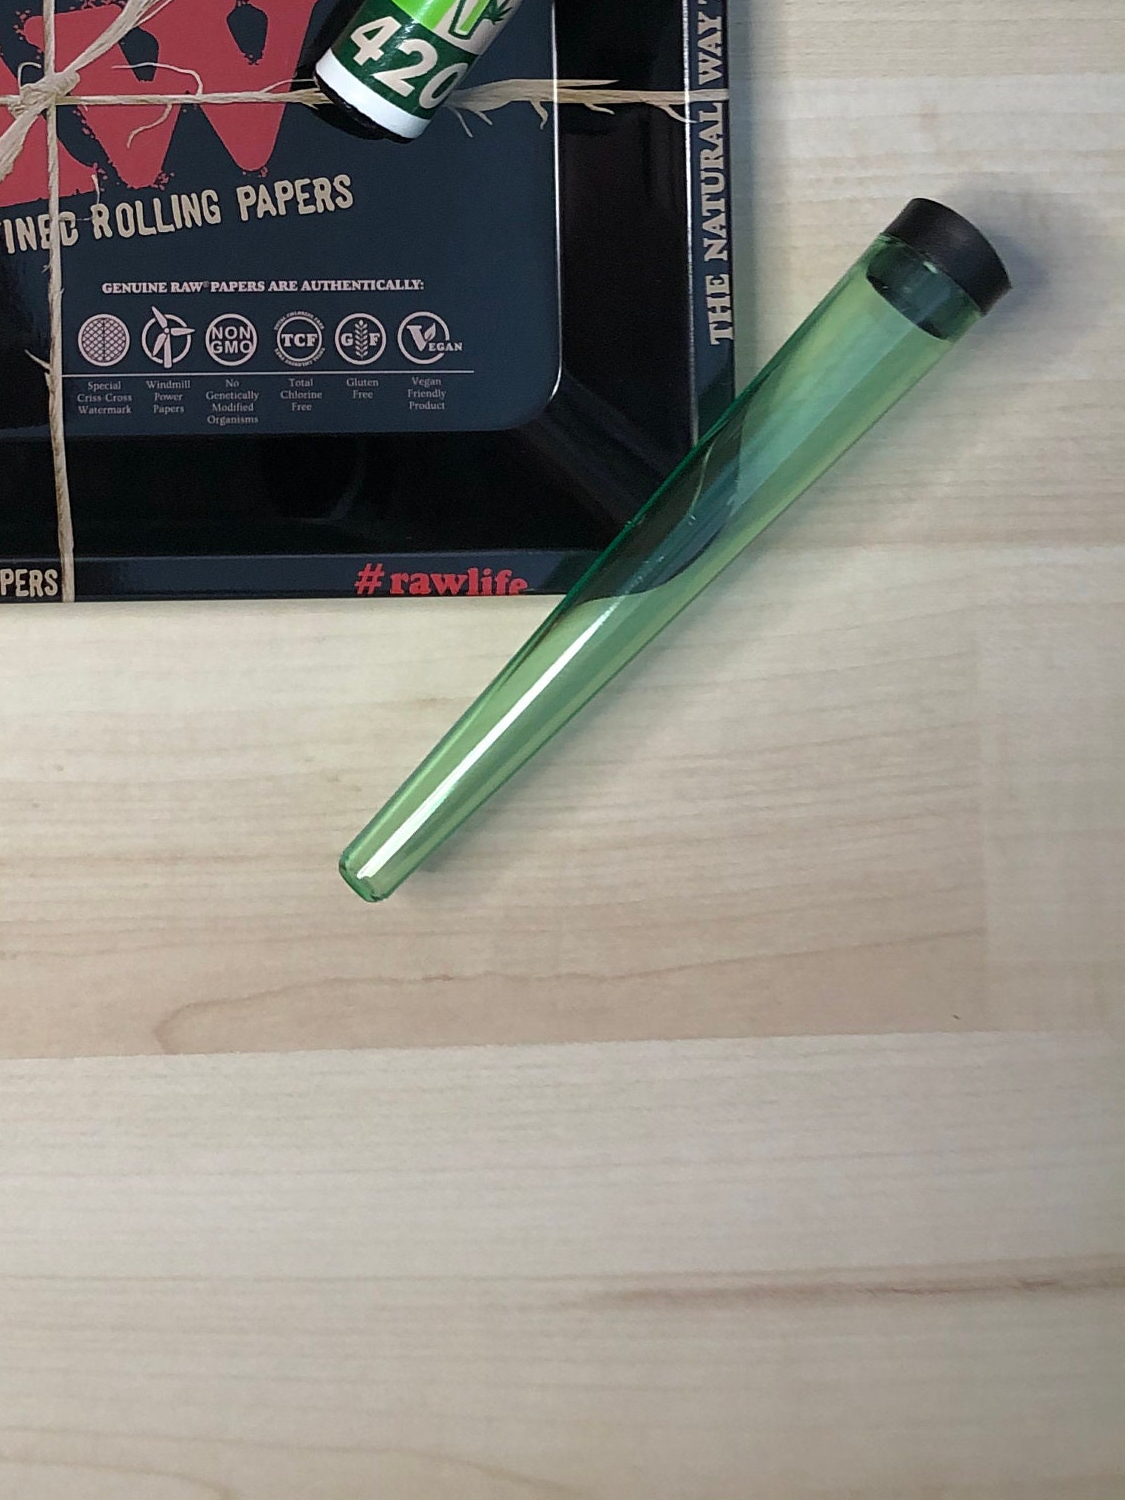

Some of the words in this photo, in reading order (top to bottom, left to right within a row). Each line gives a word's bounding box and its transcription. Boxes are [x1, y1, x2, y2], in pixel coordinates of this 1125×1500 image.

[697, 11, 723, 86] WAY
[350, 15, 469, 109] 420
[698, 102, 728, 262] NATURAL
[90, 189, 222, 240] ROLLING
[236, 174, 354, 221] PAPERS
[101, 281, 168, 294] GENUINE
[210, 280, 265, 293] PAPERS
[267, 280, 297, 292] ARE
[300, 279, 425, 291] AUTHENTICALLY:
[705, 273, 734, 346] THE
[211, 325, 252, 340] NON
[281, 333, 318, 347] TCF
[210, 340, 252, 354] GMO
[87, 380, 122, 392] Special
[146, 379, 191, 389] Windmill
[225, 378, 240, 388] No
[288, 378, 314, 387] Total
[346, 377, 379, 387] Gluten
[411, 376, 442, 387] Vegan
[77, 393, 101, 402] Criss
[105, 393, 133, 402] Cross
[154, 392, 183, 402] Power
[206, 390, 260, 401] Genetically
[280, 389, 323, 399] Chlorine
[352, 389, 373, 399] Free
[407, 389, 447, 400] Friendly
[77, 405, 132, 414] Watermark
[153, 404, 185, 415] Papers
[212, 402, 254, 412] Modified
[291, 402, 312, 411] Free
[409, 401, 446, 411] Product
[207, 415, 259, 426] Organisms
[354, 563, 528, 596] #rawlife
